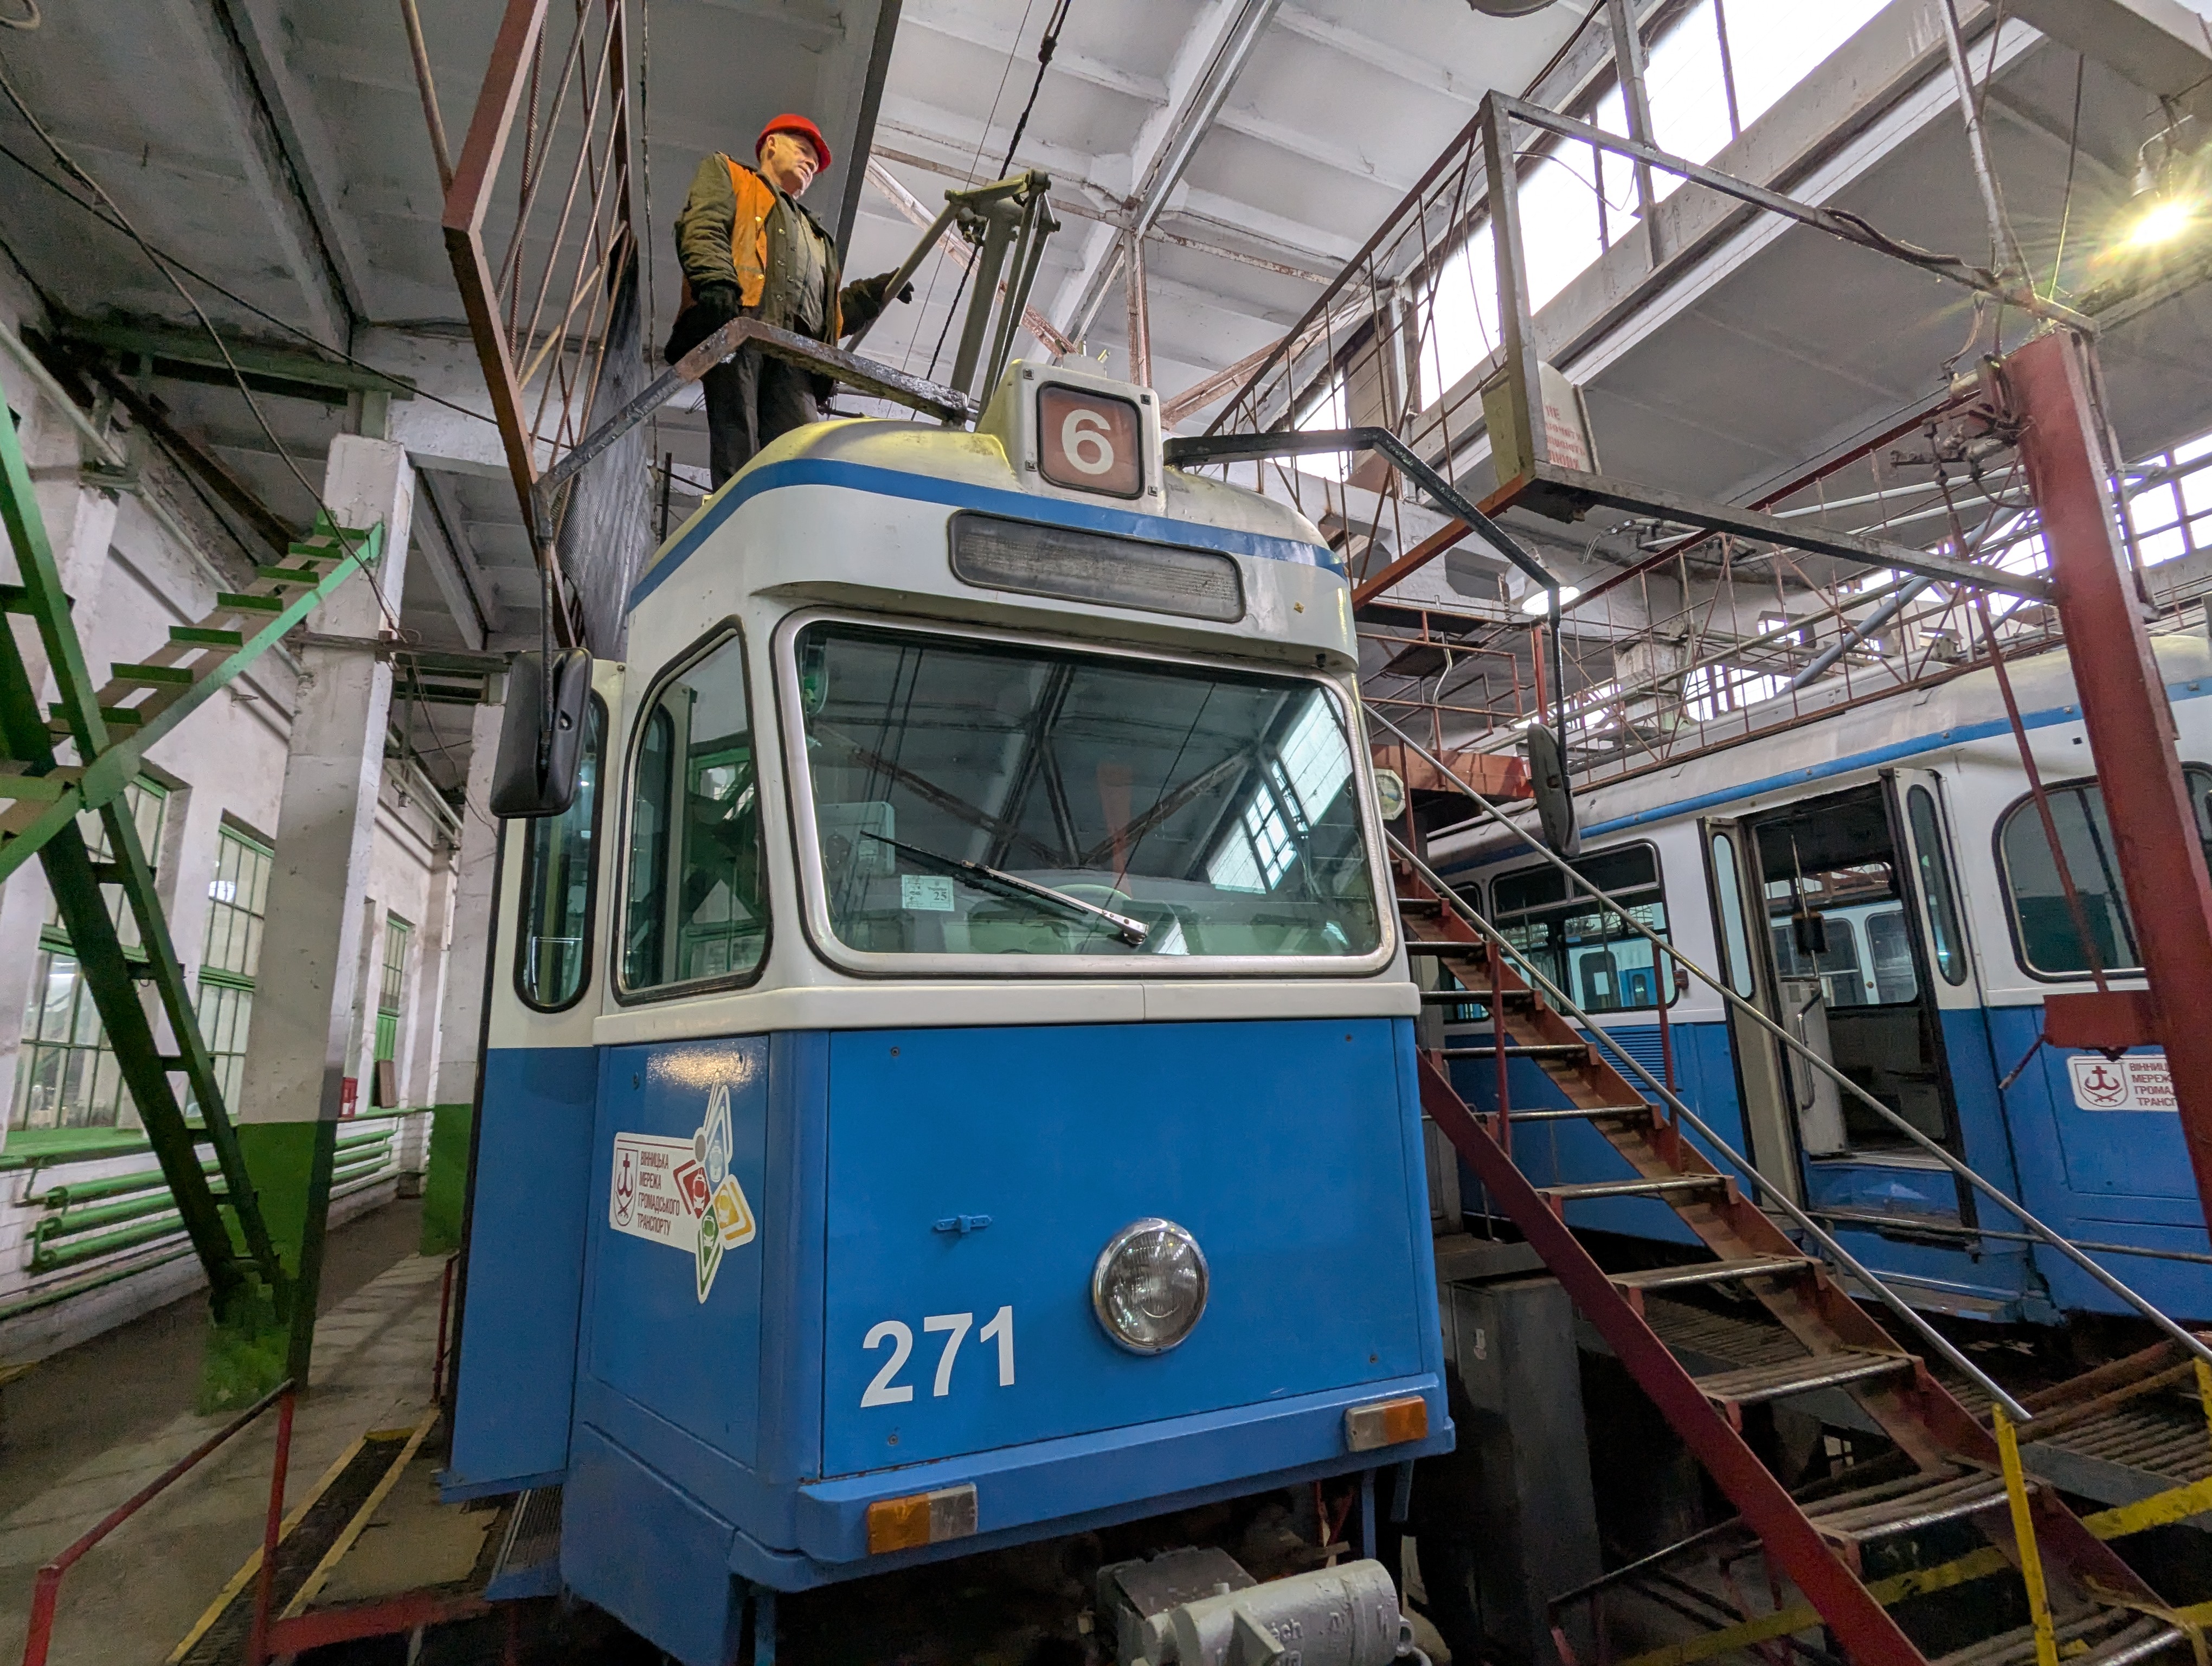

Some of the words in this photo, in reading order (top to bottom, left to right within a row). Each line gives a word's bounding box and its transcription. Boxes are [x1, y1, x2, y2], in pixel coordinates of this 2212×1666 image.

[1062, 409, 1114, 475] 6
[934, 892, 947, 901] 25
[2134, 1086, 2172, 1094] ГРОМА
[640, 1151, 669, 1170] ВІННИЦЬКА
[639, 1171, 661, 1190] МЕРЕЖА
[638, 1192, 680, 1216] ГРОМАДСЬКОГО
[637, 1213, 671, 1236] ТРАНСПОРТУ
[860, 1305, 1014, 1408] 271
